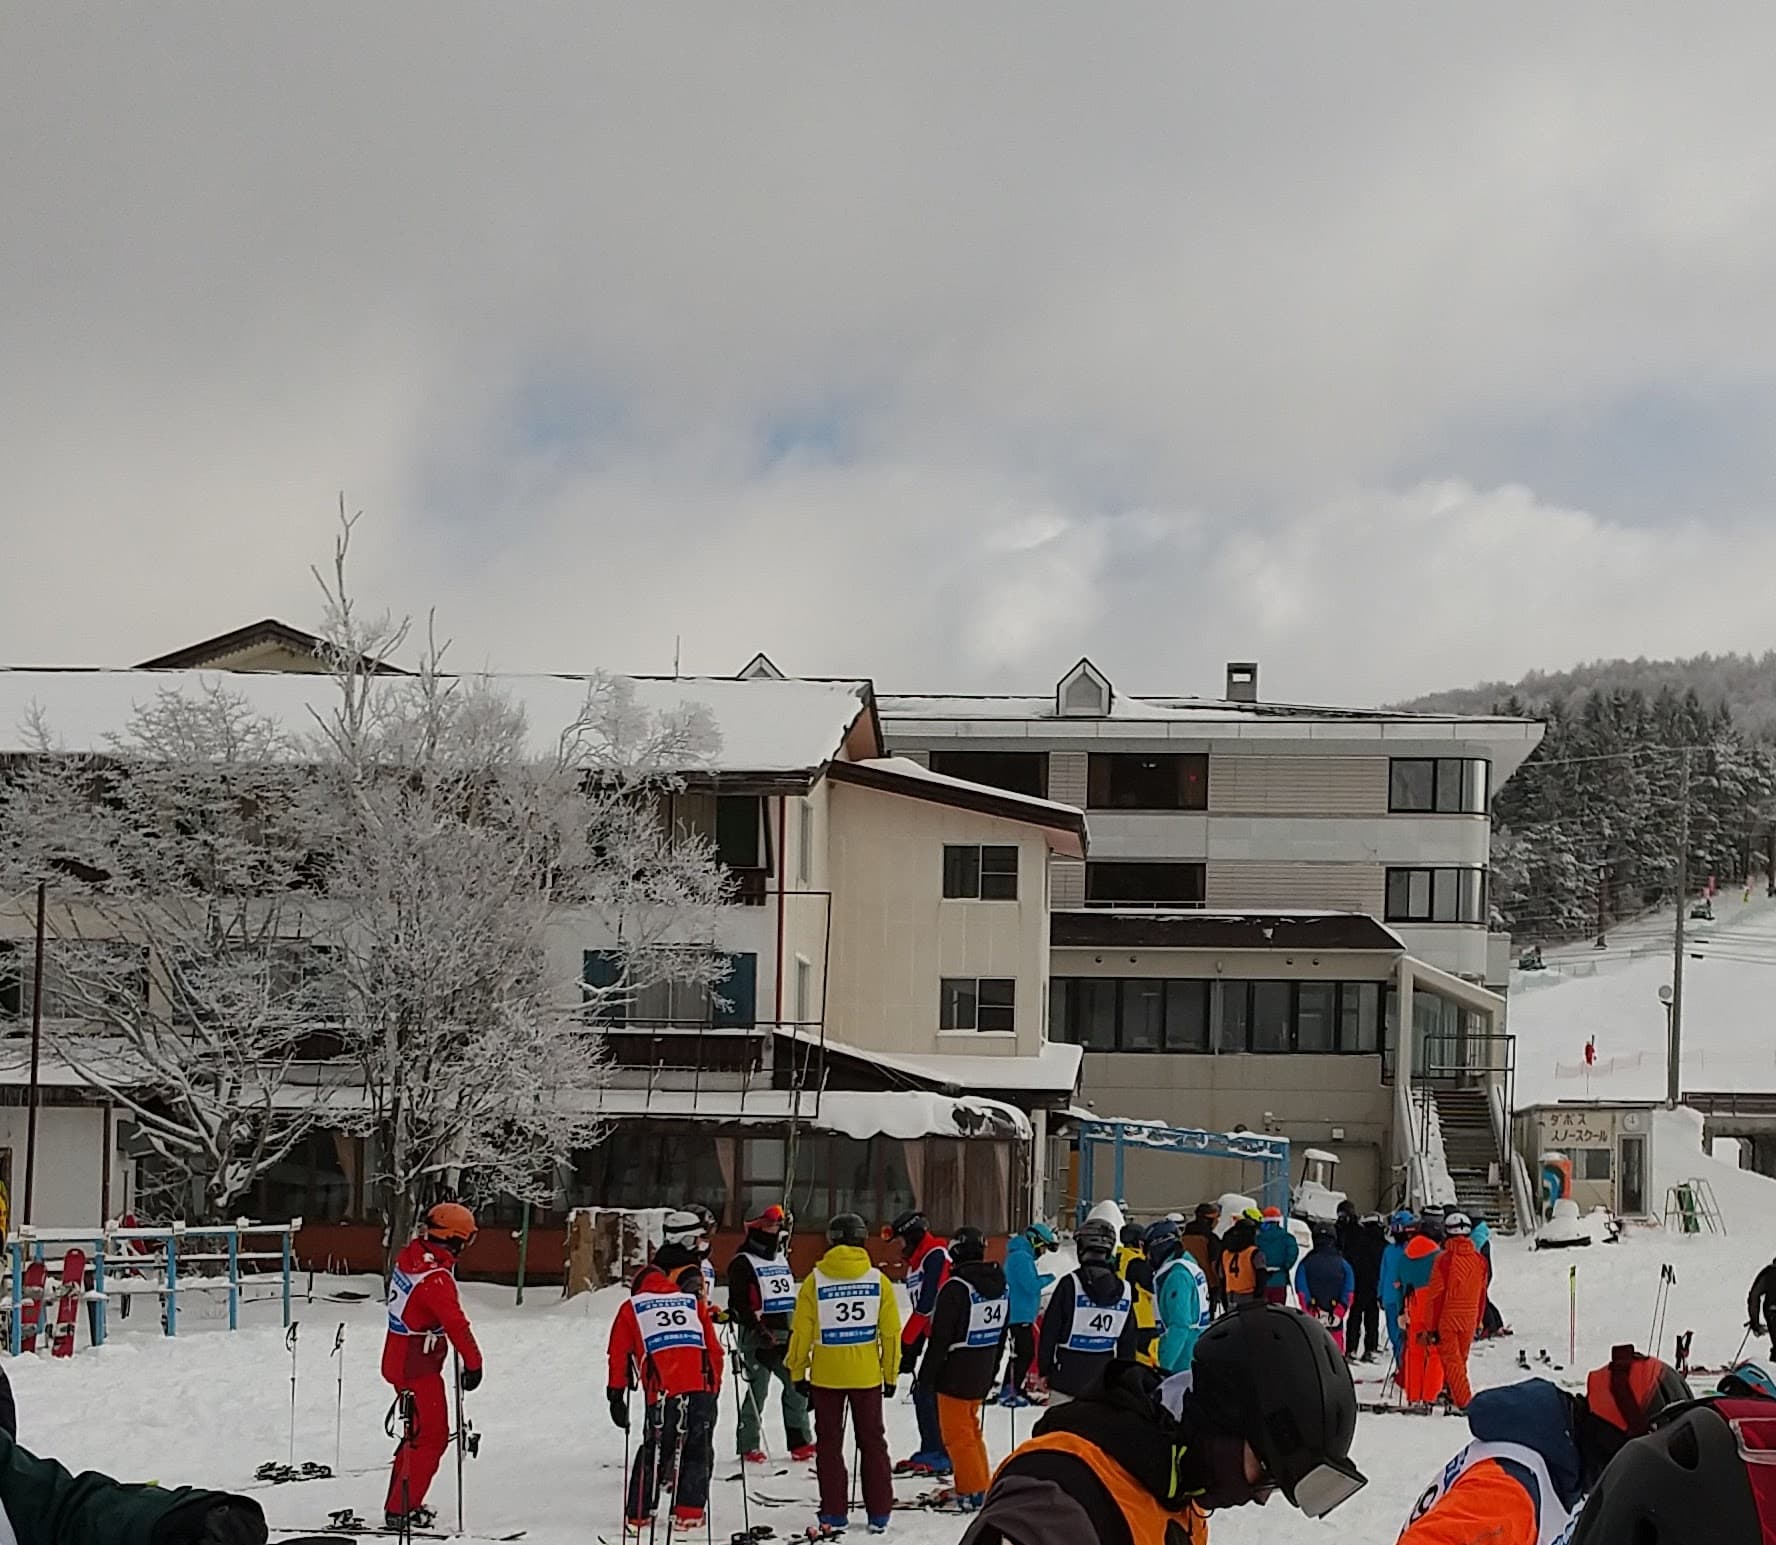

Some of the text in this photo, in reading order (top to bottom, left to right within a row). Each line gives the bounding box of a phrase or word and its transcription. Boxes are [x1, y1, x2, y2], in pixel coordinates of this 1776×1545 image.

[1550, 1113, 1587, 1126] ダボス
[1551, 1130, 1608, 1142] スノースクール
[1229, 1252, 1240, 1278] 4
[770, 1278, 791, 1294] 39
[655, 1309, 687, 1327] 36
[835, 1301, 866, 1322] 35
[983, 1304, 1002, 1324] 34
[1090, 1314, 1113, 1332] 40
